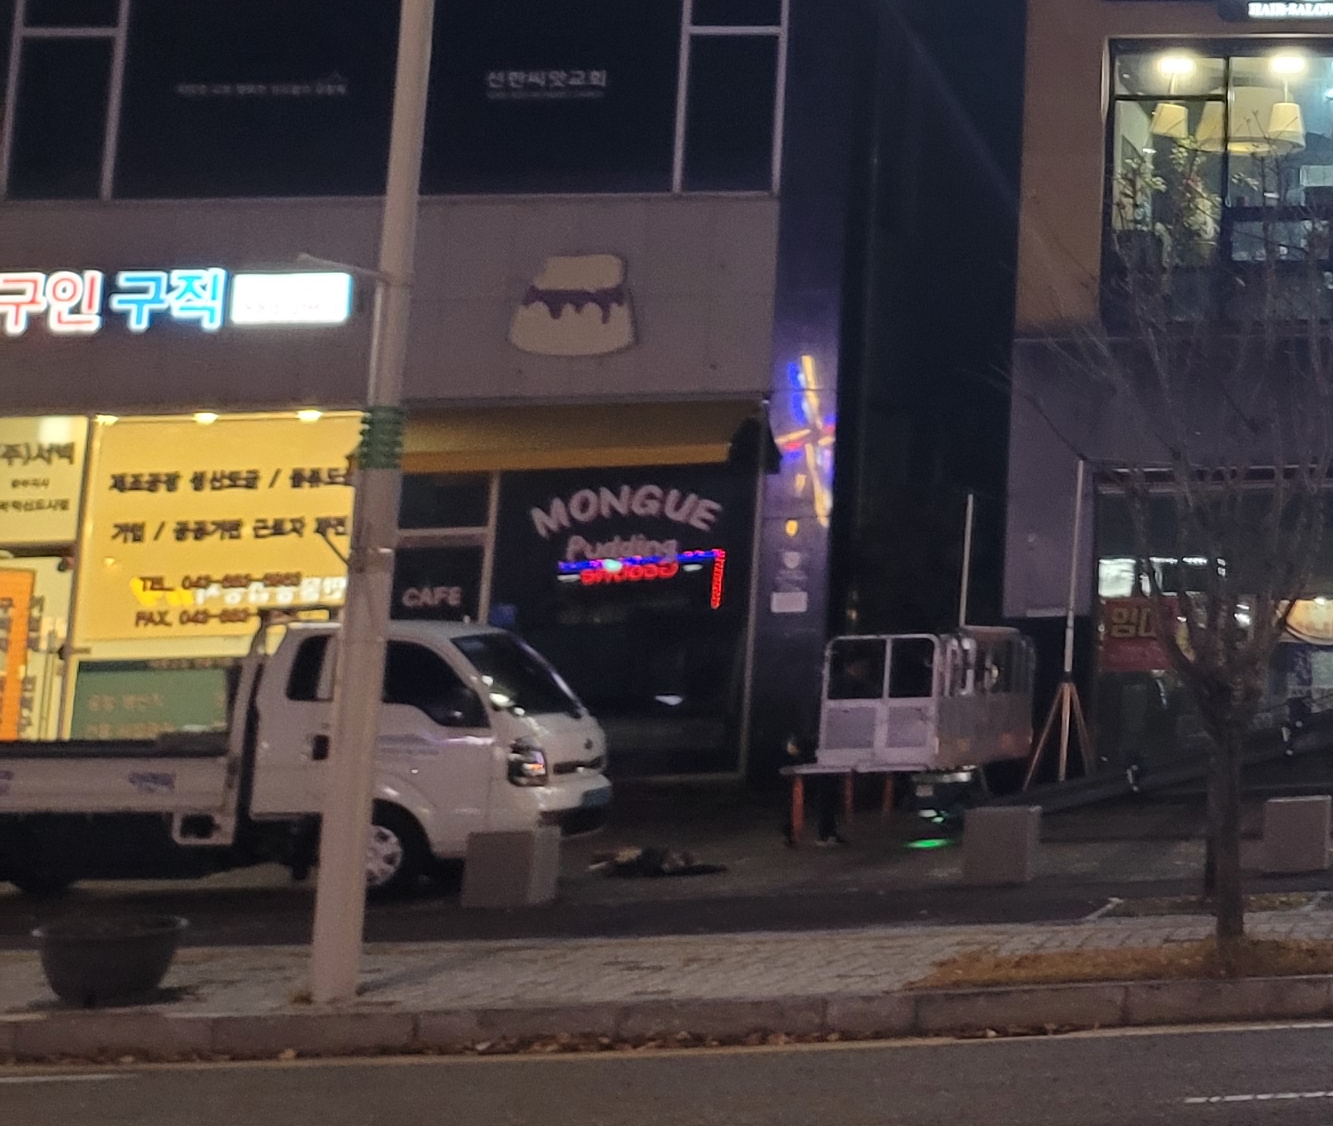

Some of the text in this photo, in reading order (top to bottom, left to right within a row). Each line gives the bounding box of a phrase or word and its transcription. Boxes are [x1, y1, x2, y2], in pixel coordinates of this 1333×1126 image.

[0, 268, 228, 333] 구인 구직
[530, 484, 723, 541] MONGUE
[402, 586, 463, 609] CAFE
